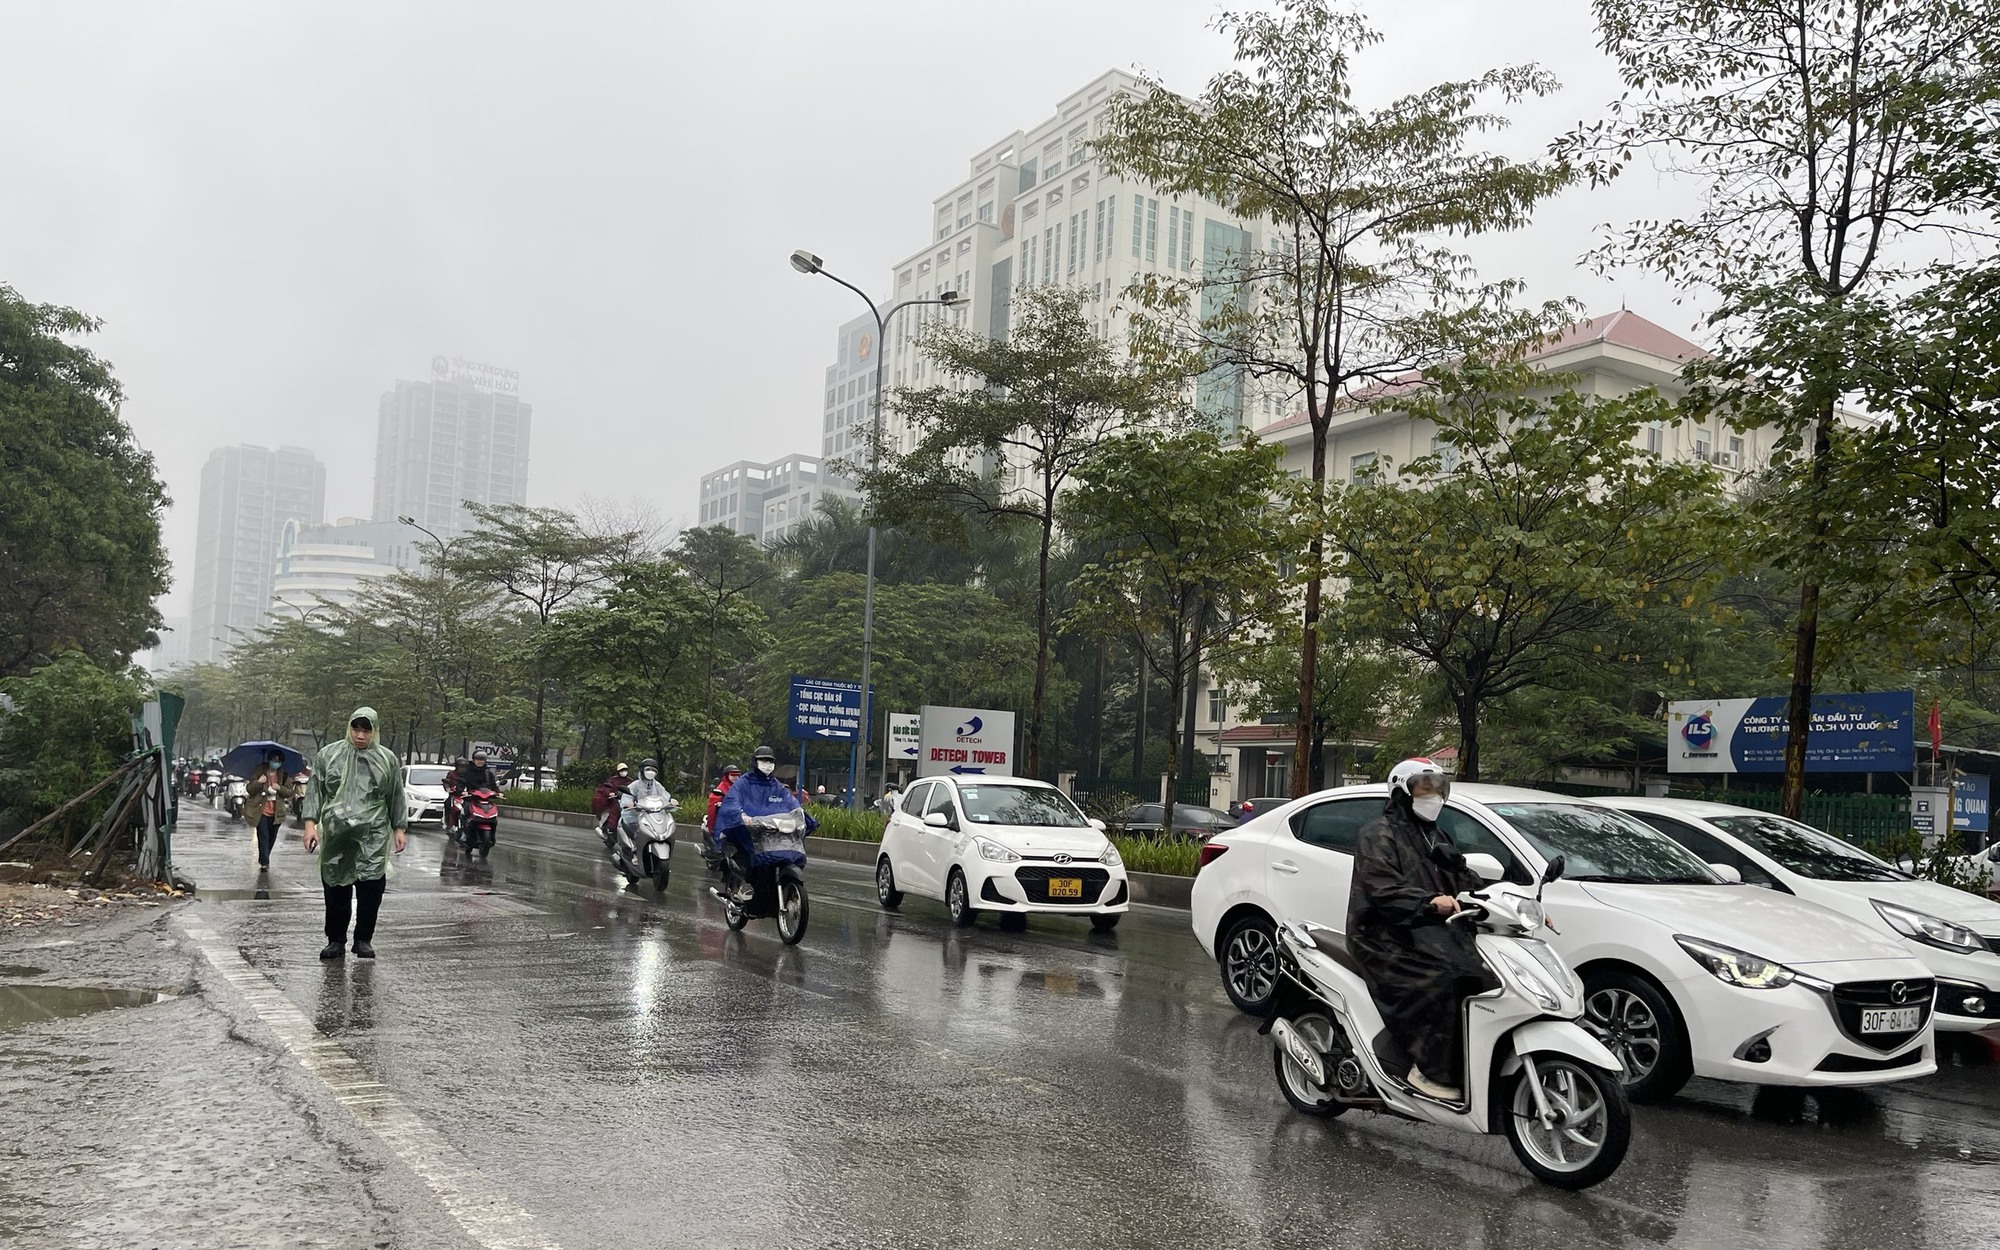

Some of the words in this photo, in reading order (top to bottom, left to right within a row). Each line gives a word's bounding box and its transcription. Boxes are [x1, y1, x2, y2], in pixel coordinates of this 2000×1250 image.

[1744, 715, 1768, 725] CÔNG
[1771, 716, 1782, 724] TY
[1850, 713, 1864, 721] TƯ
[1688, 722, 1712, 735] ILS
[1840, 723, 1854, 732] VỤ
[957, 736, 983, 744] DETECH
[931, 747, 968, 763] DETECH
[973, 750, 1006, 765] TOWER
[1213, 788, 1219, 796] 12
[1966, 798, 1987, 815] QUAN
[1059, 879, 1073, 888] 30F
[1475, 1003, 1497, 1015] HONDA
